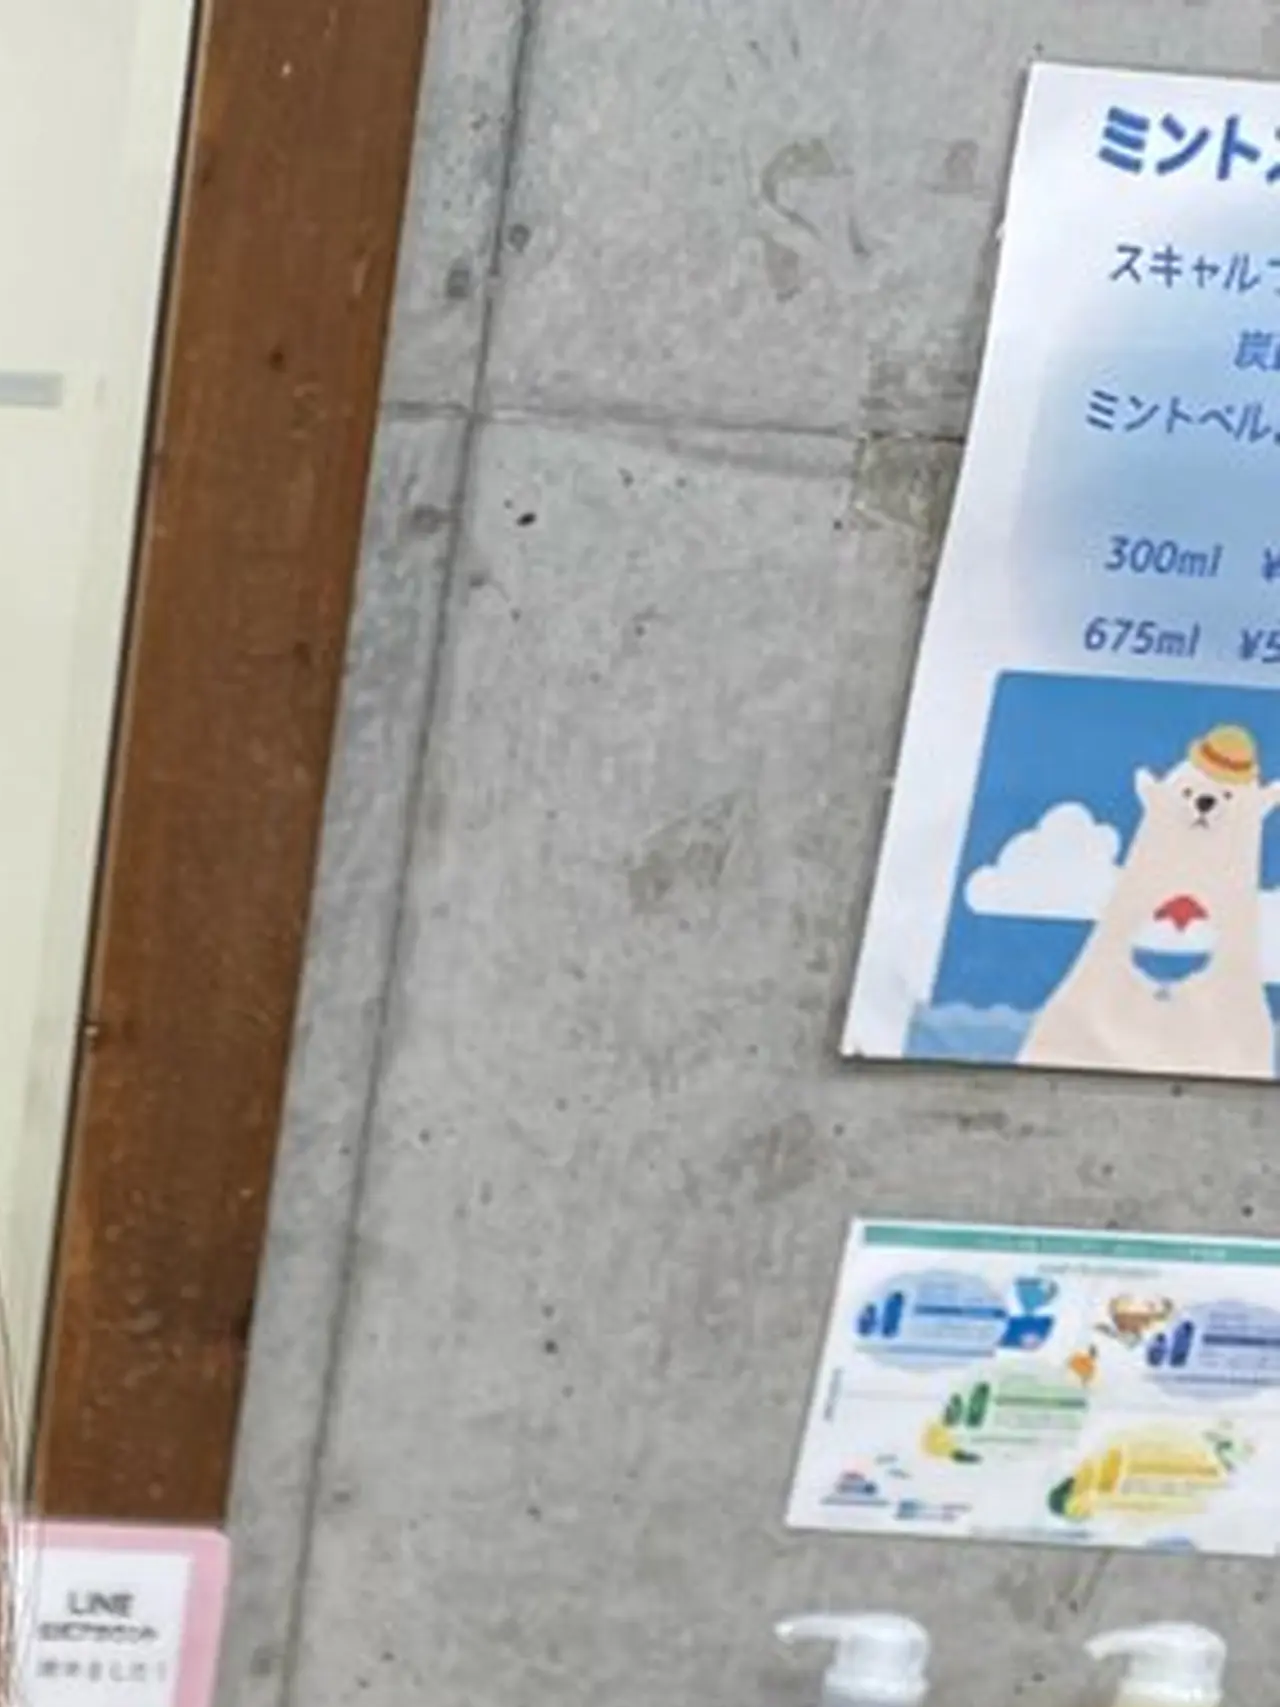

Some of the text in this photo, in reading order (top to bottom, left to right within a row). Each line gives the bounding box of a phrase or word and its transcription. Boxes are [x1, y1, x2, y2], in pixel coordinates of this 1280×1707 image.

[1098, 106, 1280, 184] ミント
[1234, 329, 1280, 372] 炭
[1086, 390, 1280, 446] ミントベル
[1104, 536, 1224, 578] 300ml
[1084, 616, 1200, 658] 675ml
[67, 1590, 135, 1619] LINE
